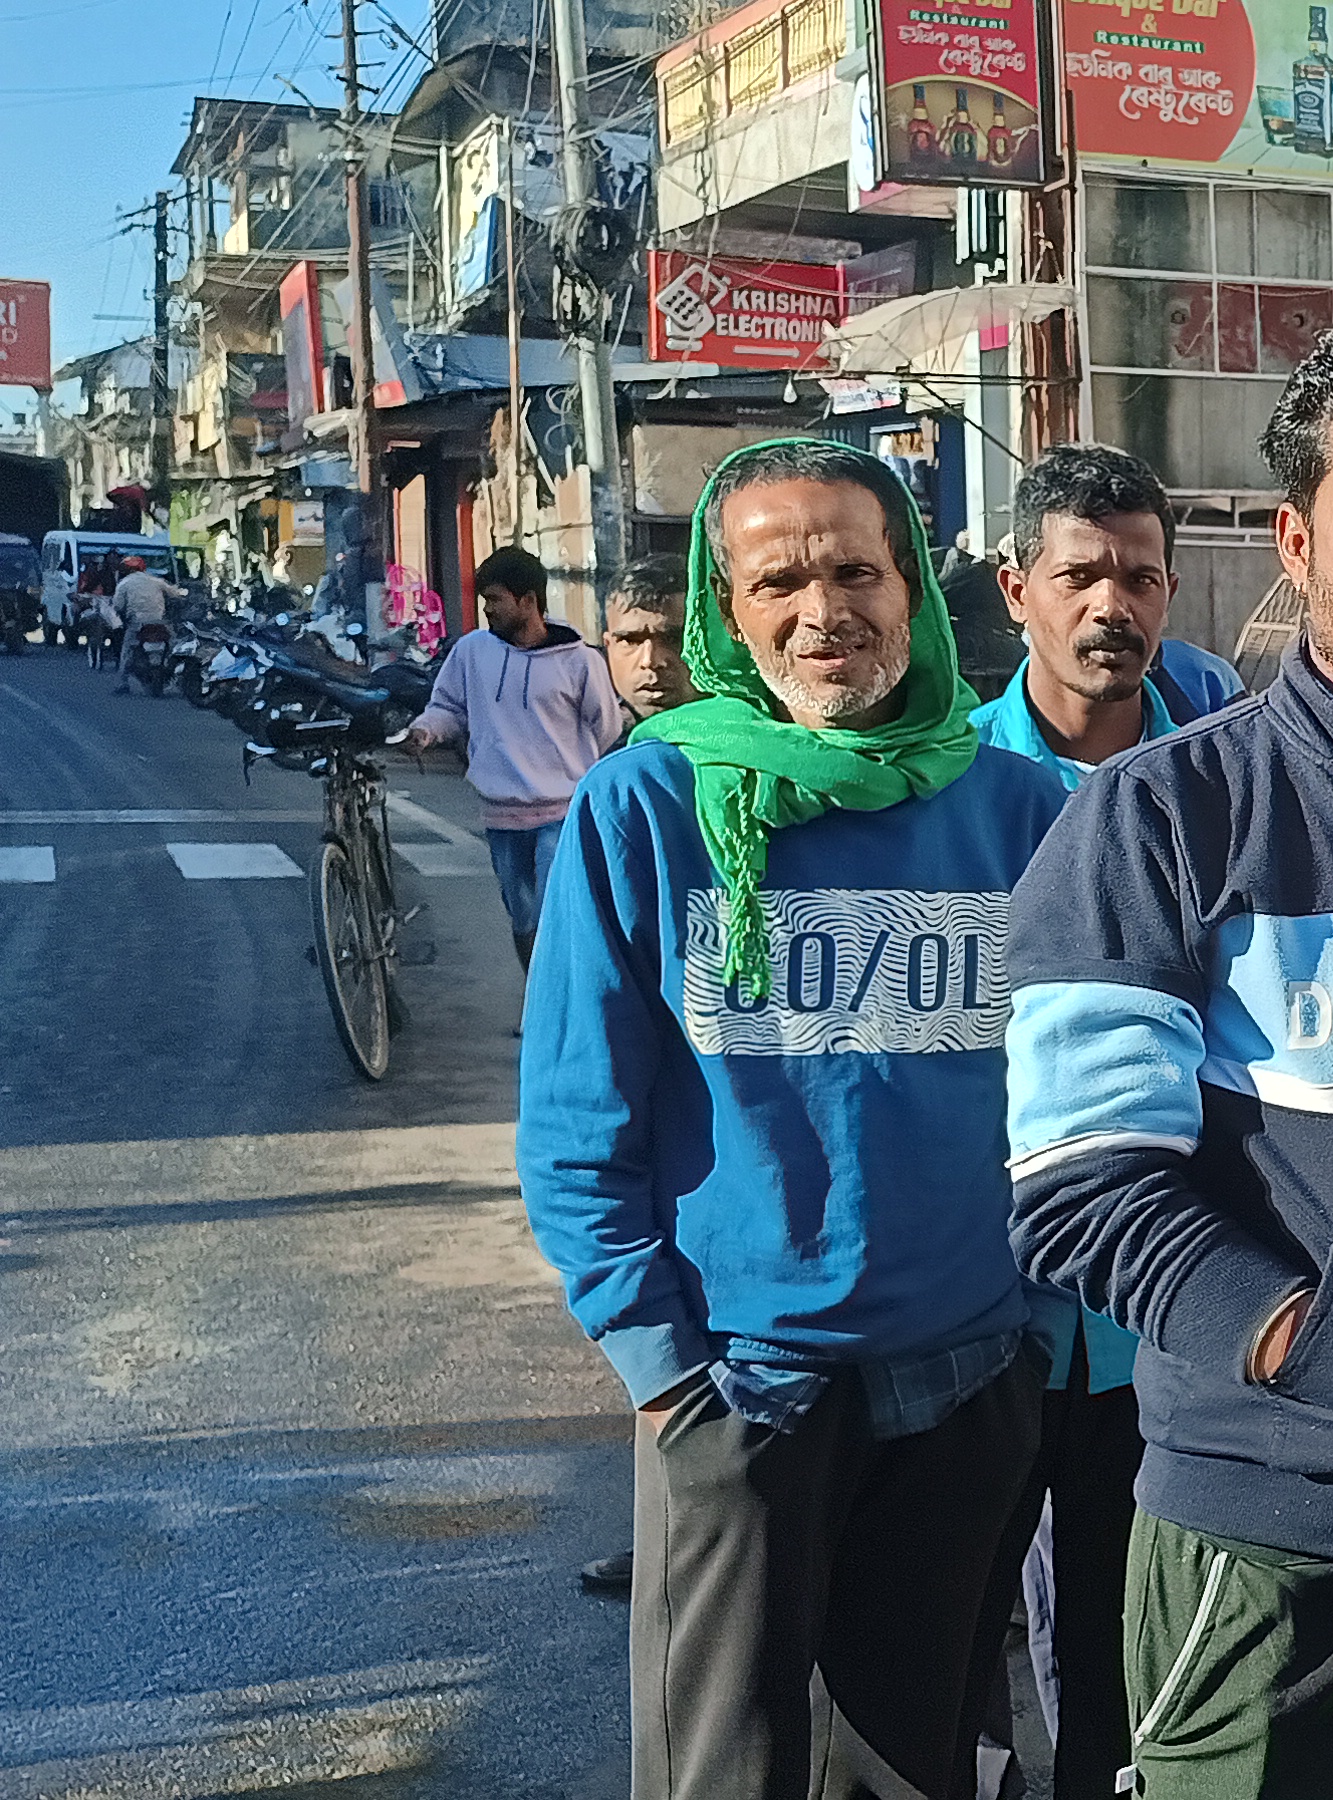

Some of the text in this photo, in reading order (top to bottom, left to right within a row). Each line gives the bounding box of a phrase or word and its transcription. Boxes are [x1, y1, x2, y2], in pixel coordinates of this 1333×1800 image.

[909, 9, 1009, 30] Restaurant
[1141, 13, 1157, 33] &
[1096, 29, 1203, 54] Restaurant
[732, 289, 837, 318] KRISHNA
[715, 313, 824, 343] ELECTRONI
